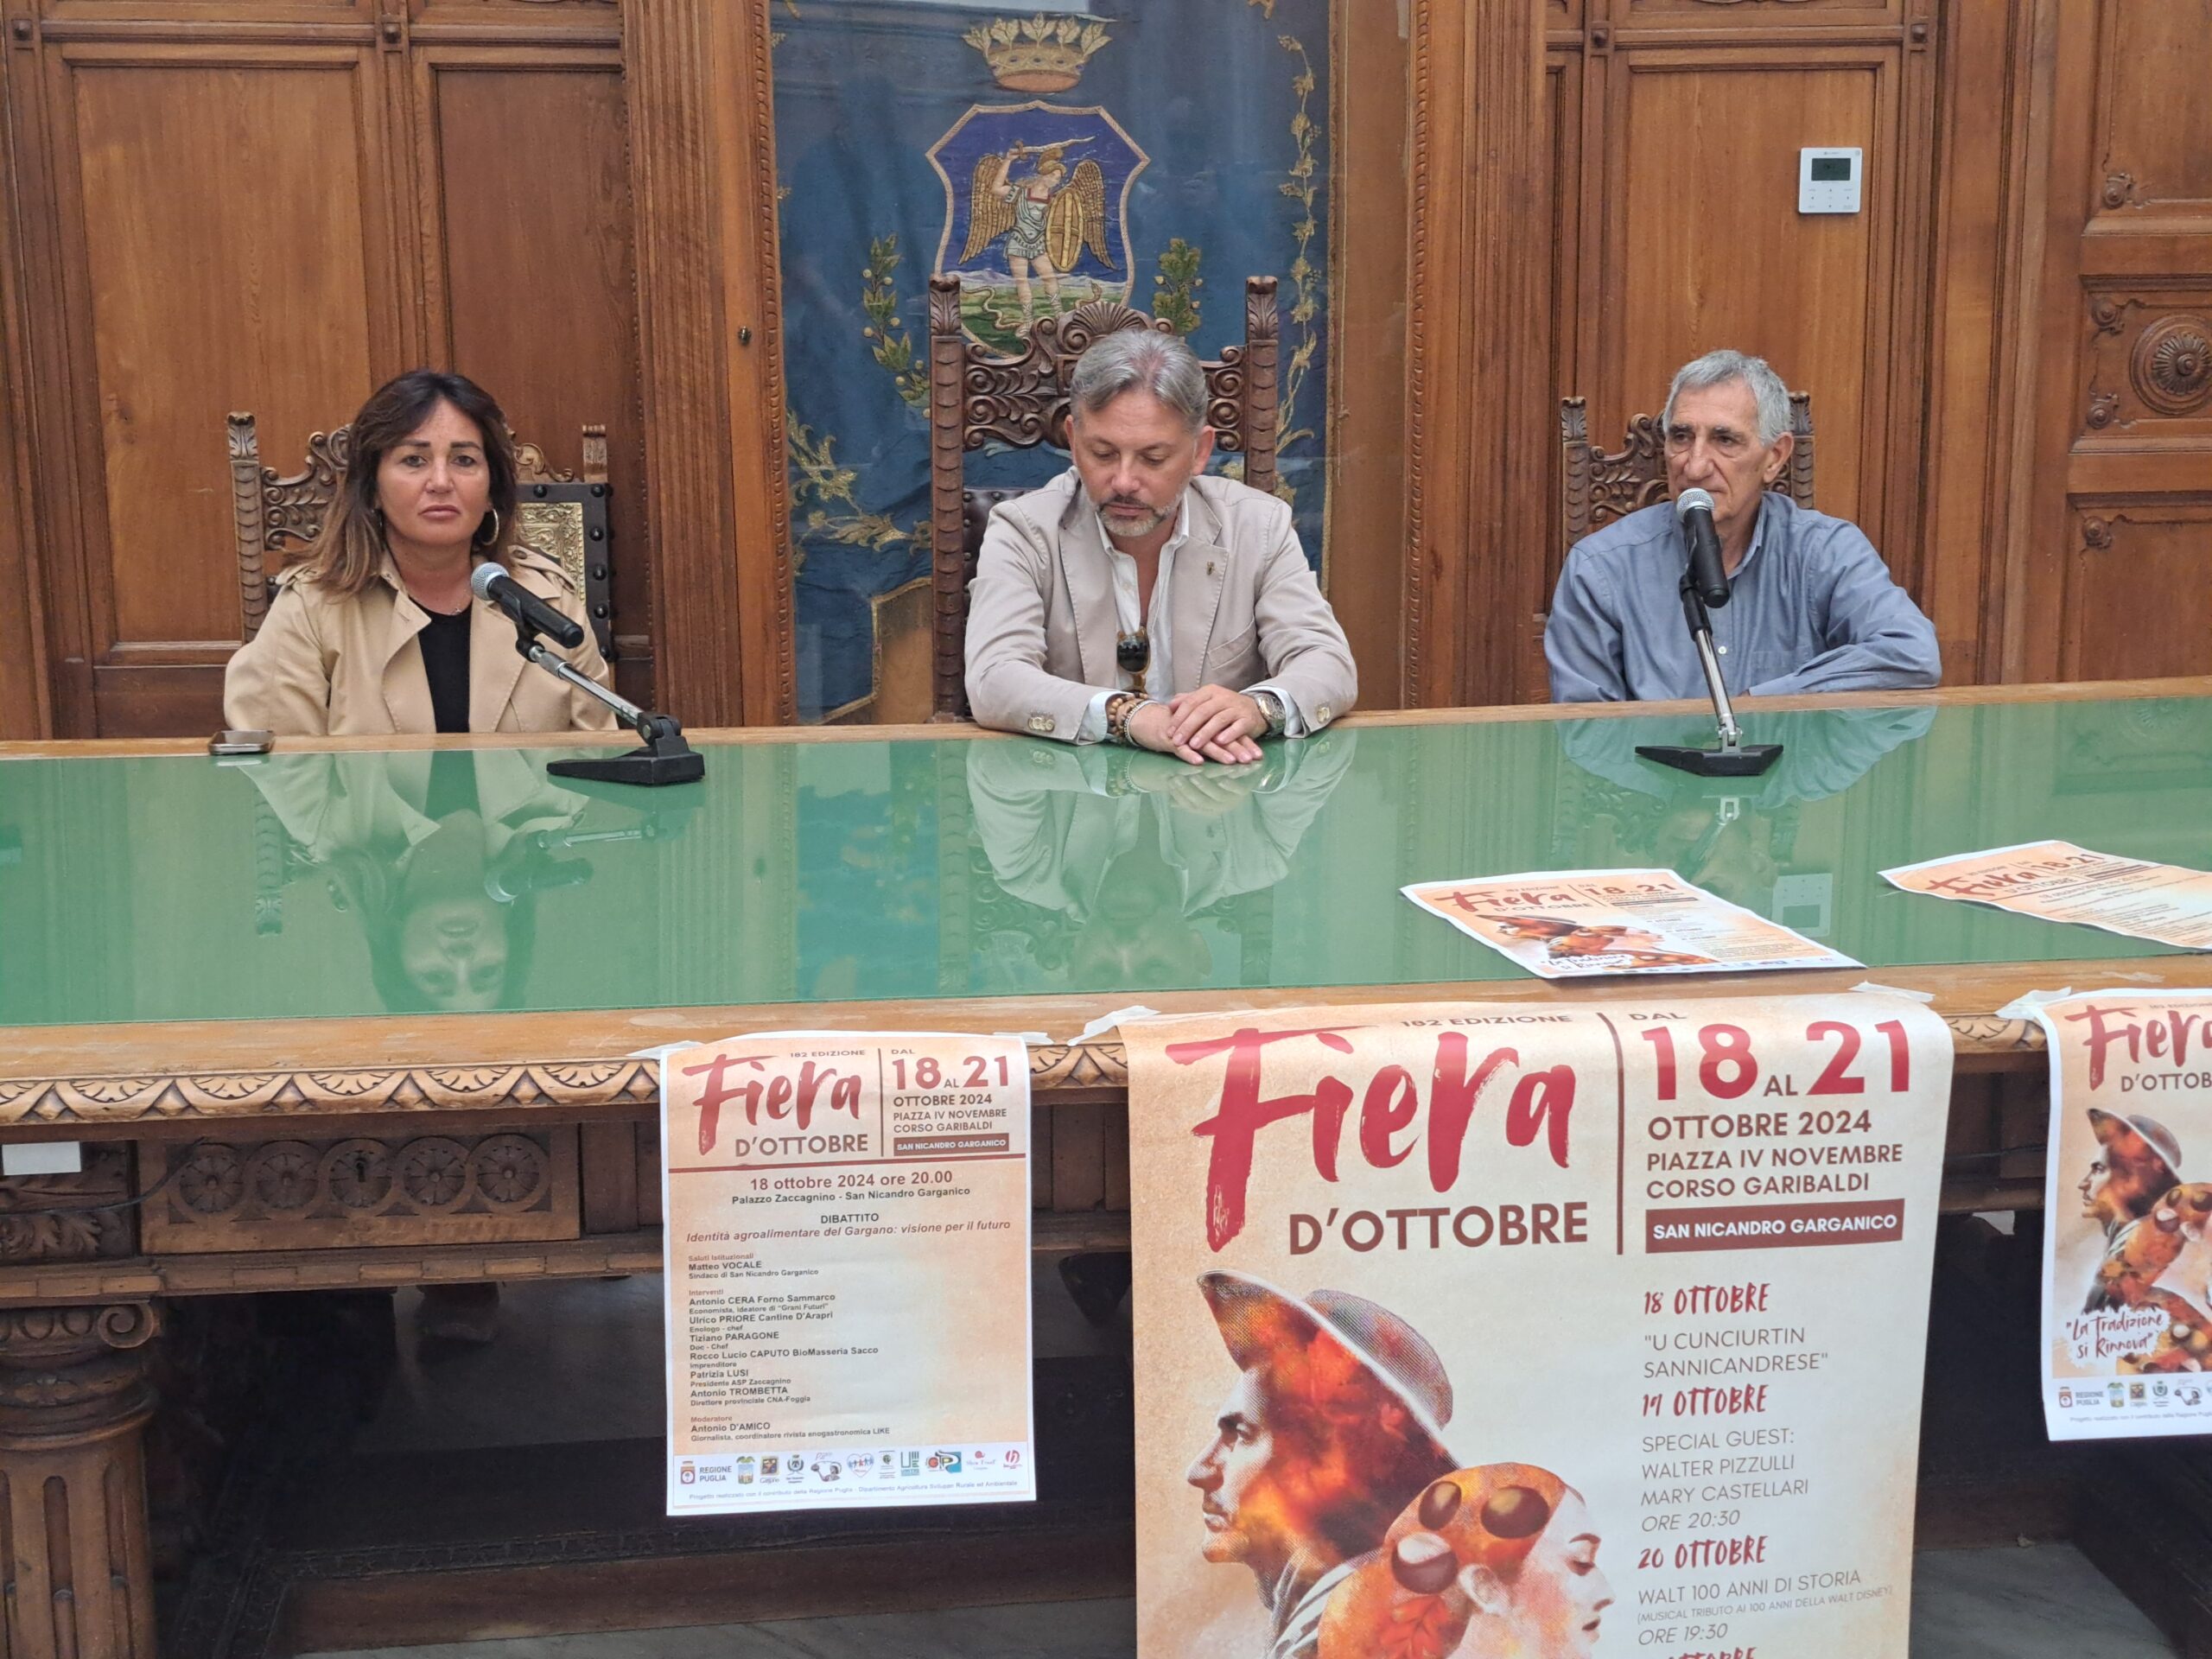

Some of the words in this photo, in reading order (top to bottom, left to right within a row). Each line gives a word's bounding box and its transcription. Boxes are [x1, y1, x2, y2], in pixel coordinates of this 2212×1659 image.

[1434, 891, 1576, 912] Fiera
[1448, 1015, 1573, 1026] EDIZIONE
[892, 1056, 941, 1090] 18
[944, 1078, 959, 1089] AL
[963, 1055, 1008, 1088] 21
[1639, 1024, 1758, 1102] 18
[1762, 1074, 1798, 1098] AL
[1805, 1020, 1910, 1096] 21
[682, 1053, 861, 1155] Fiera
[893, 1095, 955, 1107] OTTOBRE
[959, 1094, 992, 1105] 2024
[893, 1111, 931, 1121] PIAZZA
[934, 1110, 944, 1120] IV
[948, 1108, 1007, 1119] NOVEMBRE
[1648, 1111, 1789, 1139] OTTOBRE
[1797, 1109, 1872, 1134] 2024
[893, 1123, 933, 1133] CORSO
[937, 1122, 992, 1131] GARIBALDI
[1166, 1025, 1577, 1252] Fiera
[735, 1134, 868, 1157] D'OTTOBRE
[915, 1141, 956, 1150] NICANDRO
[957, 1139, 1006, 1148] GARGANICO
[1648, 1150, 1733, 1173] PIAZZA
[1740, 1148, 1764, 1166] IV
[1771, 1143, 1904, 1166] NOVEMBRE
[750, 1178, 767, 1191] 18
[774, 1175, 832, 1190] ottobre
[837, 1173, 875, 1188] 2024
[880, 1175, 906, 1185] ore
[911, 1171, 953, 1185] 20.00
[1646, 1176, 1736, 1199] CORSO
[1744, 1173, 1870, 1195] GARIBALDI
[732, 1196, 772, 1205] Palazzo
[775, 1193, 835, 1205] Zaccagnino
[845, 1192, 864, 1200] San
[868, 1190, 914, 1199] Nicandro
[918, 1187, 970, 1199] Garganico
[821, 1213, 879, 1224] DIBATTITO
[1289, 1201, 1587, 1255] D'OTTOBRE
[1653, 1224, 1690, 1240] SAN
[1694, 1218, 1785, 1239] NICANDRO
[1790, 1213, 1897, 1236] GARGANICO
[687, 1231, 730, 1242] Identità
[733, 1229, 820, 1242] agroalimentare
[823, 1227, 842, 1236] del
[845, 1225, 897, 1238] Gargano:
[901, 1224, 941, 1234] visione
[944, 1222, 963, 1234] per
[966, 1221, 974, 1230] il
[976, 1220, 1010, 1230] futuro
[1675, 1282, 1770, 1314] OTTOBRE
[720, 1314, 755, 1323] PRIORE
[2090, 1312, 2163, 1340] Tradizione
[1645, 1334, 1667, 1351] "U
[1674, 1327, 1804, 1350] CUNCIURTIN
[2077, 1343, 2088, 1358] si
[793, 1348, 849, 1357] BioMasseria
[1644, 1353, 1828, 1378] SANNICANDRESE"
[691, 1389, 726, 1397] Antonio
[729, 1387, 788, 1395] TROMBETTA
[1674, 1383, 1769, 1416] OTTOBRE
[1643, 1433, 1719, 1452] SPECIAL
[1726, 1428, 1795, 1446] GUEST:
[1643, 1460, 1713, 1479] WALTER
[1720, 1455, 1794, 1474] PIZZULLI
[1641, 1488, 1695, 1506] MARY
[1701, 1479, 1808, 1502] CASTELLARI
[1642, 1515, 1681, 1532] ORE
[1688, 1510, 1740, 1529] 20:30
[1638, 1548, 1664, 1569] 20
[1675, 1535, 1768, 1569] OTTOBRE
[1639, 1586, 1685, 1605] WALT
[1693, 1583, 1719, 1599] 100
[1726, 1580, 1768, 1597] ANNI
[1775, 1579, 1790, 1592] DI
[1799, 1570, 1860, 1592] STORIA
[1638, 1611, 1687, 1624] (MUSICAL
[1692, 1605, 1732, 1618] TRIBUTO
[1736, 1605, 1745, 1613] AI
[1750, 1603, 1765, 1612] 100
[1769, 1600, 1792, 1611] ANNI
[1796, 1597, 1825, 1608] DELLA
[1828, 1593, 1853, 1605] WALT
[1638, 1627, 1677, 1645] ORE
[1684, 1623, 1728, 1641] 19:30
